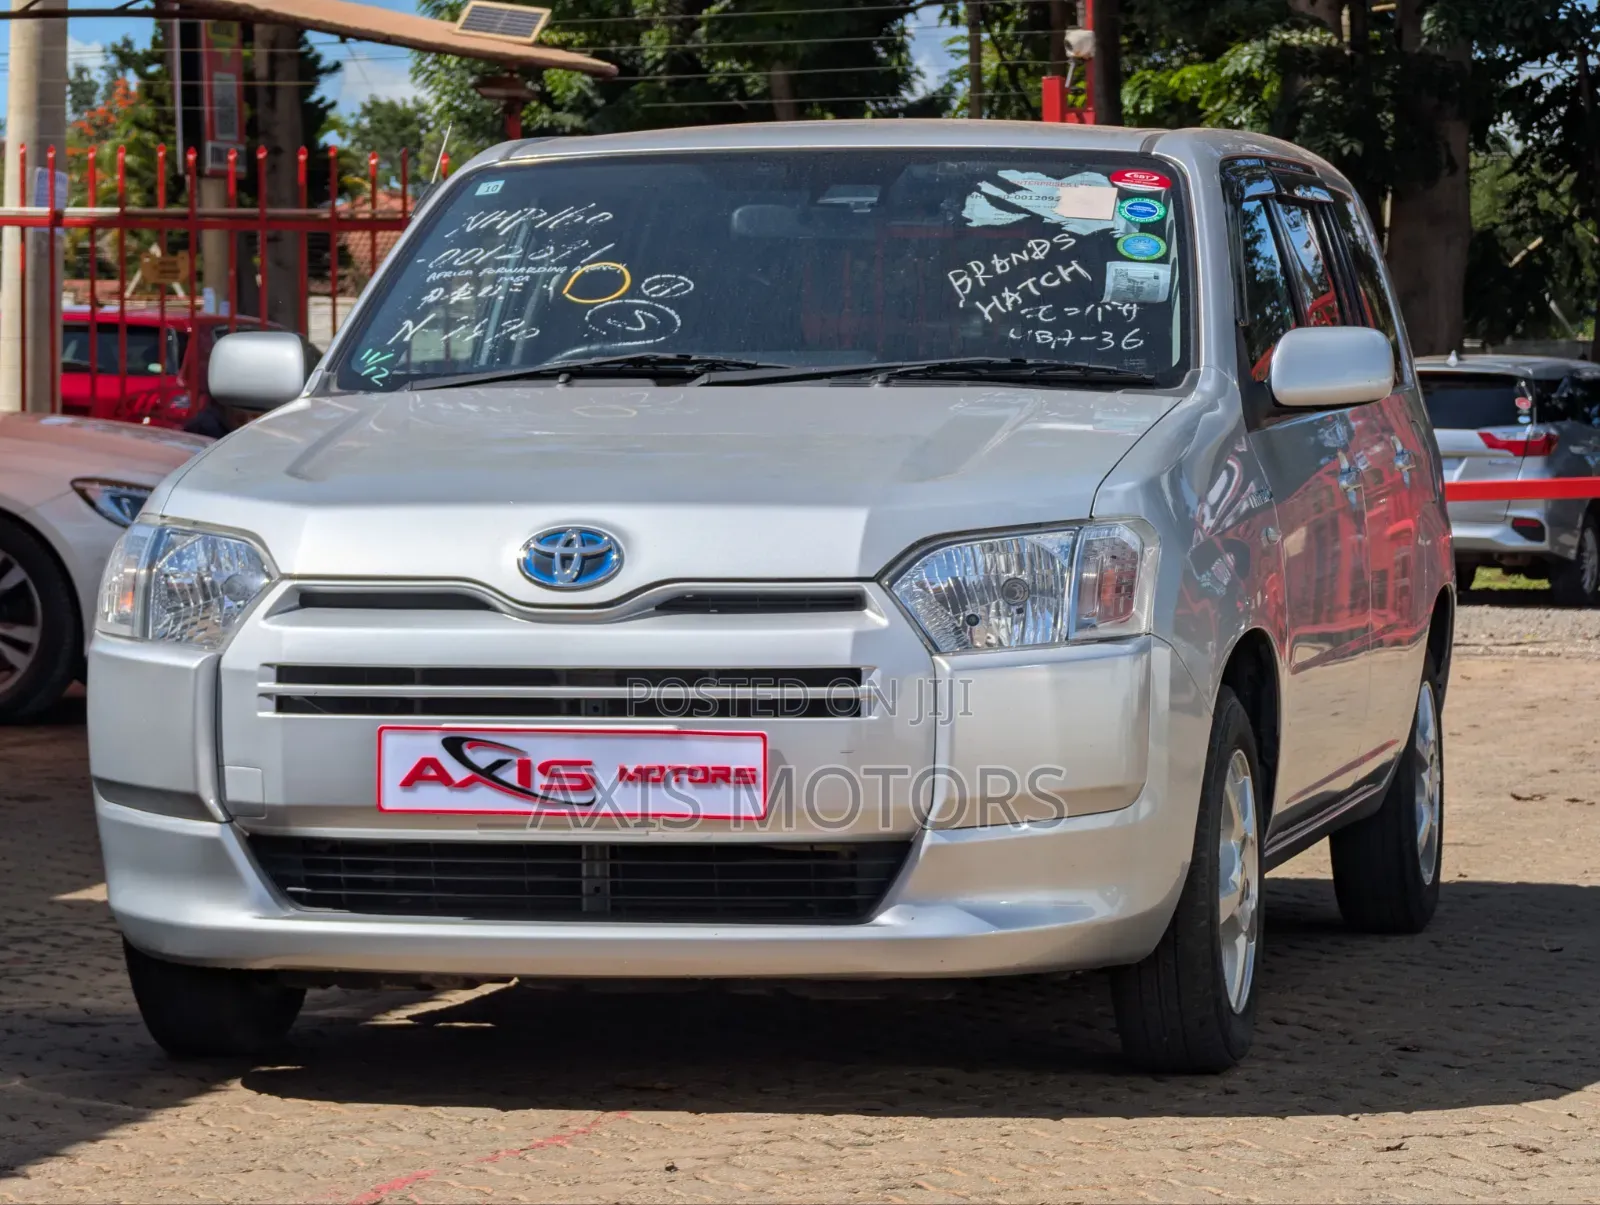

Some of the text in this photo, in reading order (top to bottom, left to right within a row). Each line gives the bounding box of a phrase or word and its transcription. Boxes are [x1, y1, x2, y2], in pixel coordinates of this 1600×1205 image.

[485, 184, 499, 193] 10
[426, 269, 473, 283] AFRICA
[478, 265, 567, 277] FORWARDING
[975, 260, 1093, 323] HATCH
[399, 745, 758, 799] AXIS MOTORS
